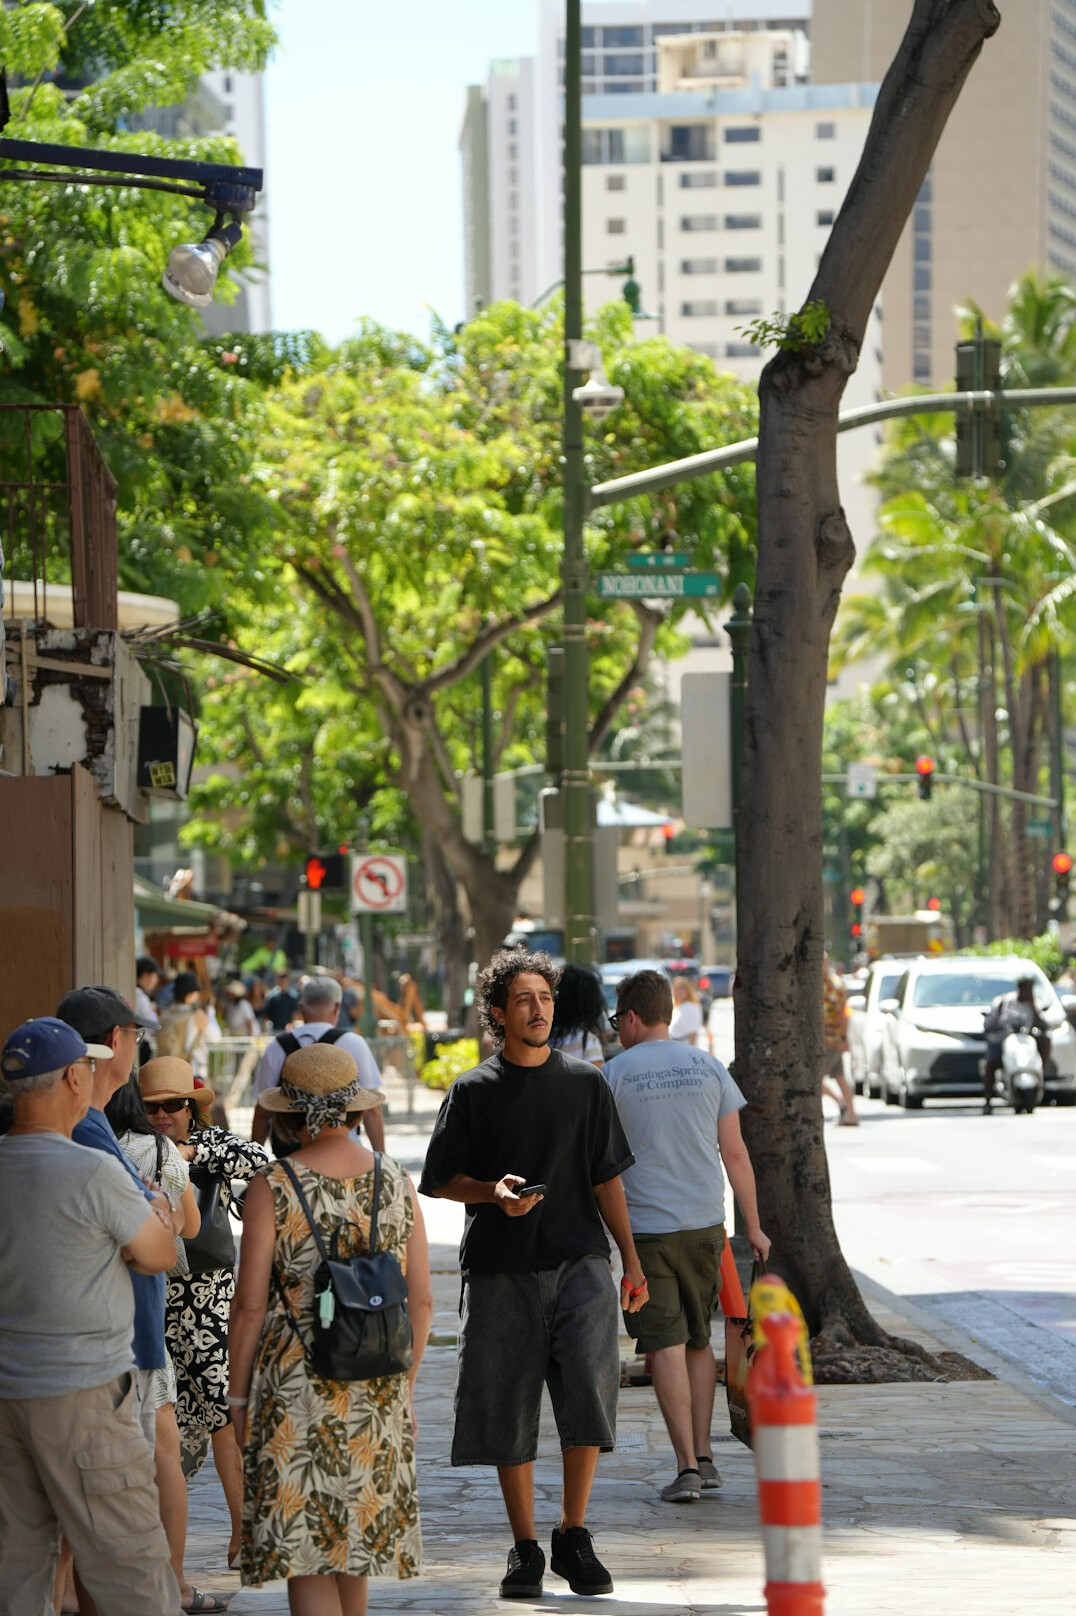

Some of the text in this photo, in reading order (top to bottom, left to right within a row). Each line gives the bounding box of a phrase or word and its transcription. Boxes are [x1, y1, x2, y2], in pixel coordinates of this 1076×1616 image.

[601, 575, 684, 594] NOHONANI
[622, 1065, 715, 1084] Saratoga Springs
[636, 1077, 704, 1092] & Company
